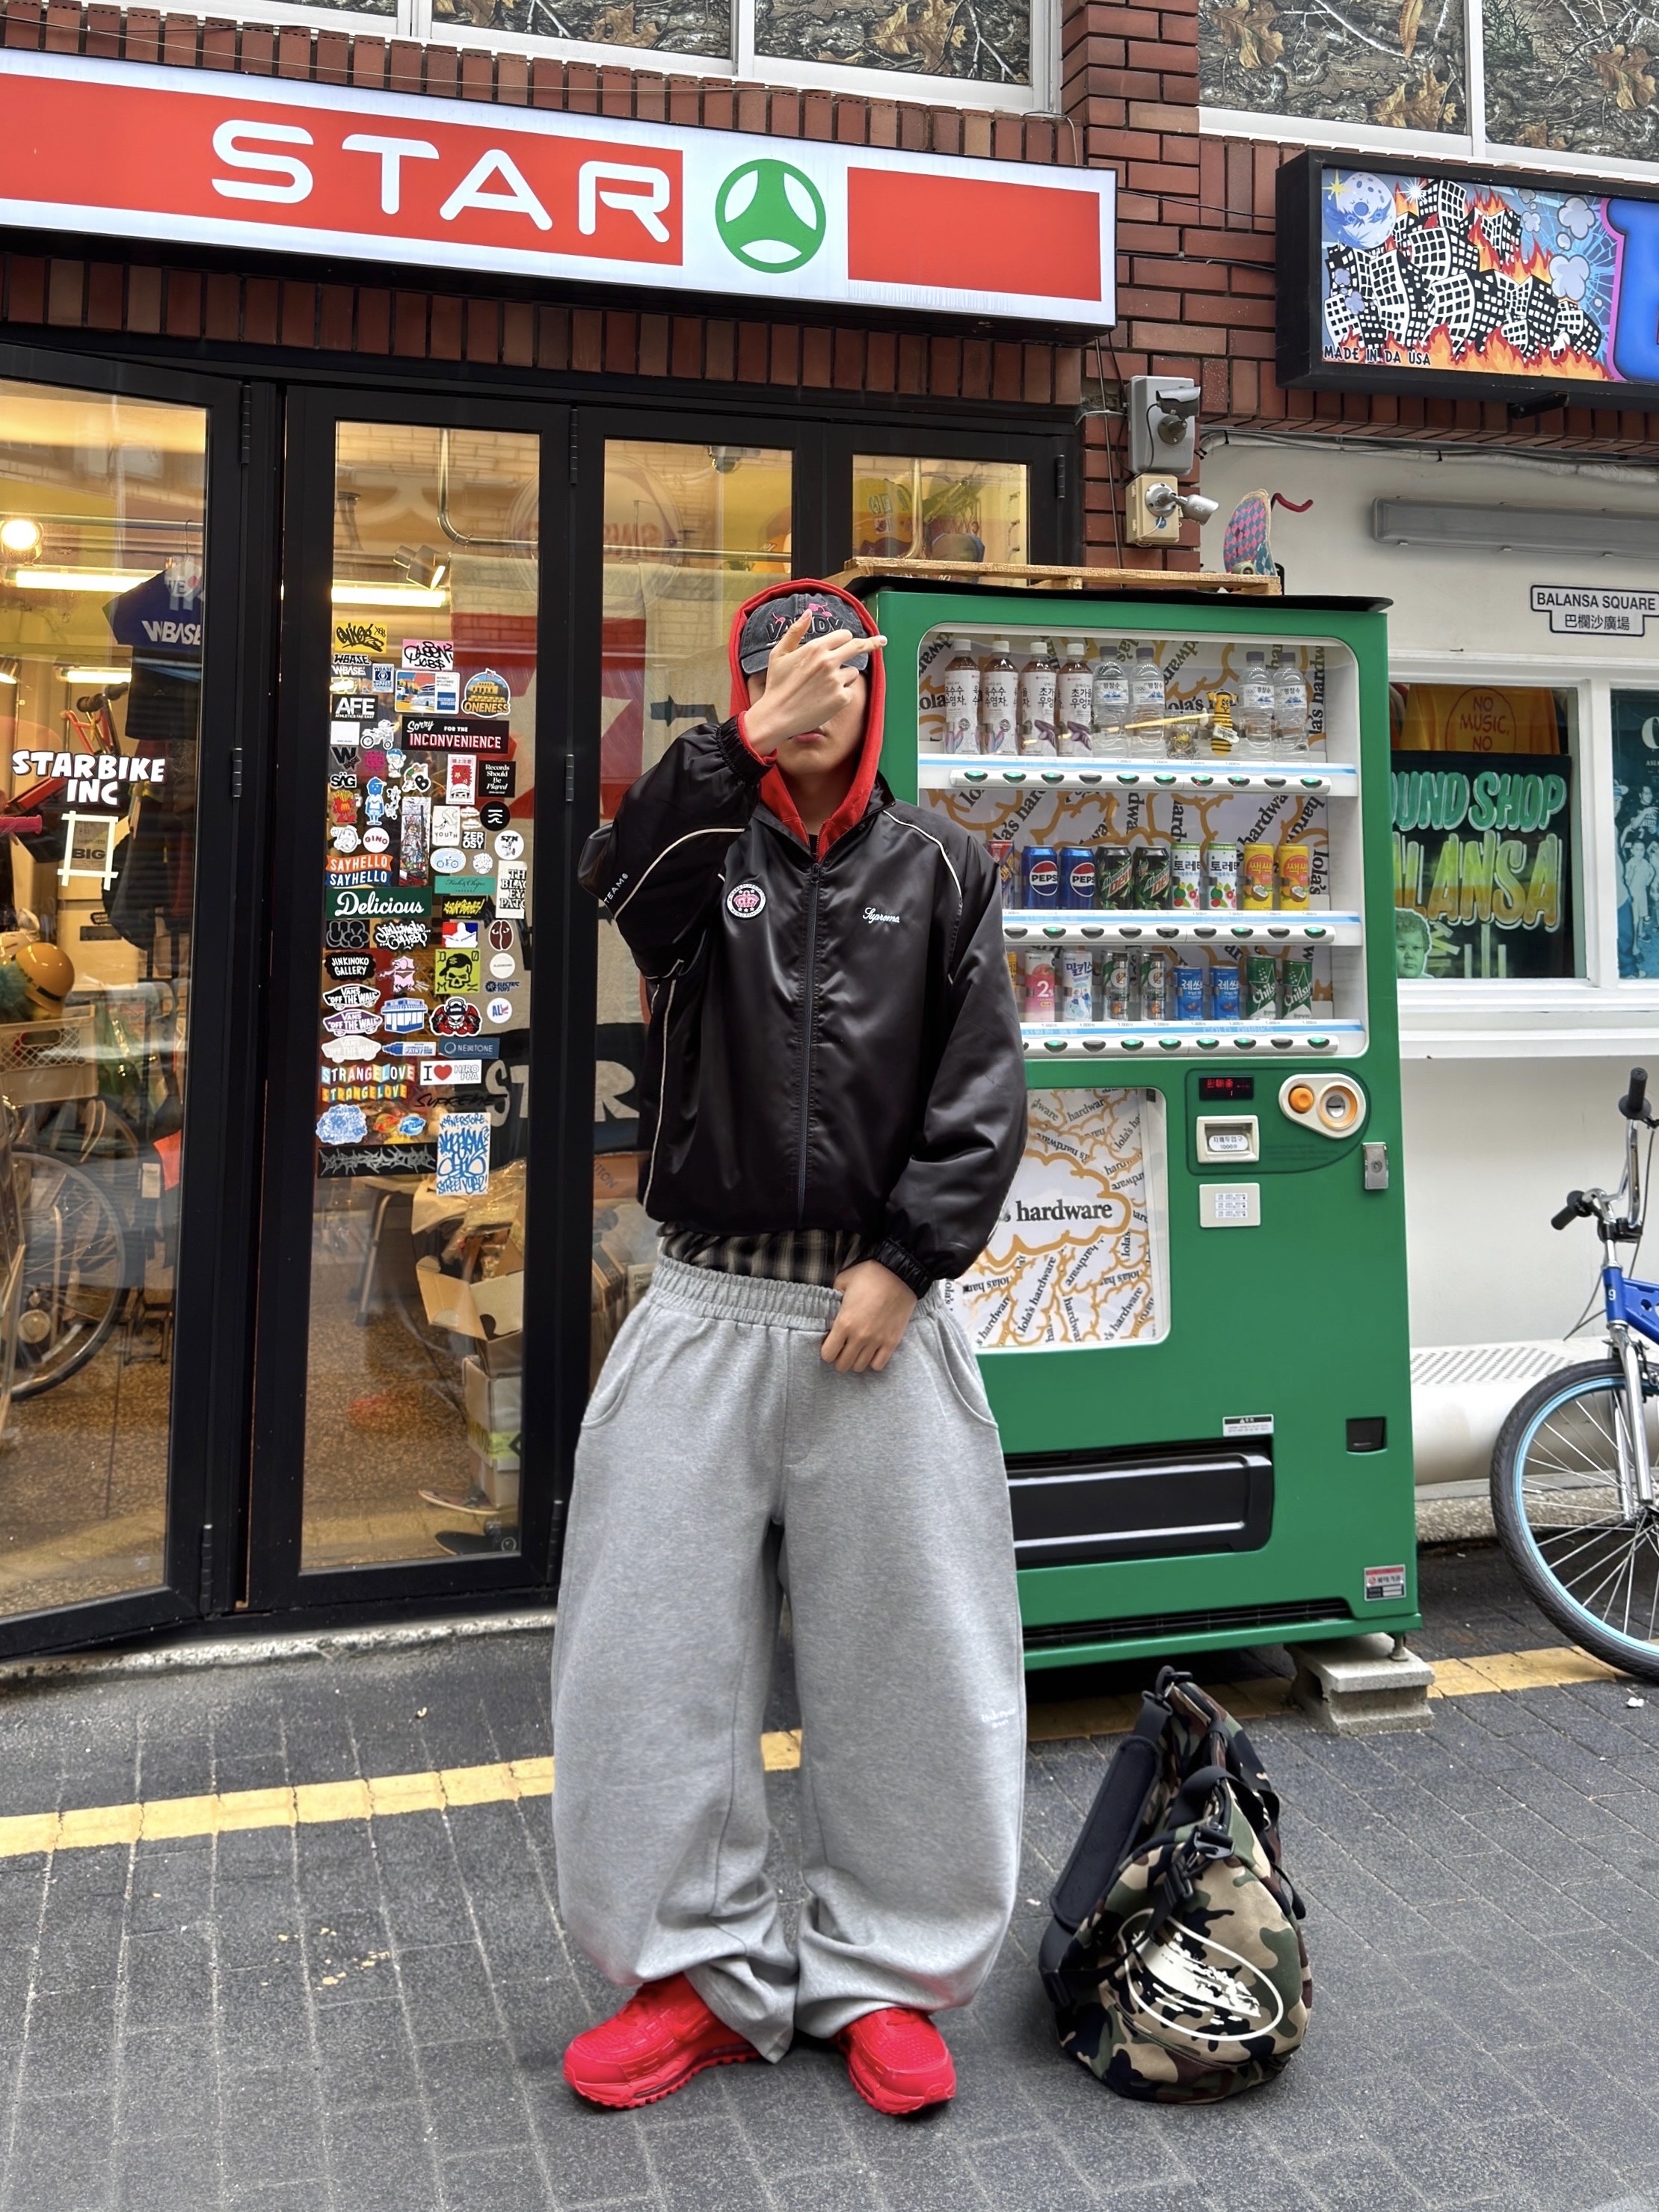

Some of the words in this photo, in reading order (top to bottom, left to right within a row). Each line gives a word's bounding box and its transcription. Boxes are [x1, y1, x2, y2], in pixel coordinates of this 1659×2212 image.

[212, 119, 670, 243] STAR
[1324, 345, 1359, 360] MADE
[1366, 348, 1377, 362] IN
[1385, 350, 1401, 363] DA
[1409, 352, 1431, 365] USA
[1537, 592, 1598, 608] BALANSA
[1602, 595, 1656, 611] SQUARE
[335, 697, 375, 715] AFE
[464, 702, 509, 713] ONENESS
[1474, 696, 1494, 712] NO
[407, 720, 434, 733] Sorry
[1459, 714, 1510, 736] MUSIC,
[410, 733, 501, 749] INCONVENIENCE
[1473, 736, 1493, 751] NO
[12, 750, 165, 783] STARBIKE
[67, 779, 118, 806] INC
[1391, 771, 1470, 831] UND
[1468, 771, 1567, 833] SHOP
[463, 839, 484, 848] OSY
[464, 831, 484, 840] ZER
[72, 848, 106, 859] BIG
[330, 855, 388, 871] SAYHELLO
[330, 870, 387, 886] SAYHELLO
[1309, 849, 1329, 895] lola's
[335, 891, 424, 916] Delicious
[331, 957, 369, 967] JINKINOKO
[334, 966, 366, 976] GALLERY
[340, 987, 360, 995] VANS
[344, 994, 358, 1005] THE
[344, 1020, 358, 1031] THE
[322, 1064, 415, 1084] STRANGELOVE
[423, 1065, 432, 1081] I
[454, 1065, 479, 1073] HIRO
[322, 1084, 407, 1103] STRANGELOVE
[1015, 1200, 1112, 1222] hardware
[1018, 1304, 1036, 1333] lola's
[1031, 1256, 1056, 1307] hardware
[1112, 1286, 1143, 1333] hardware
